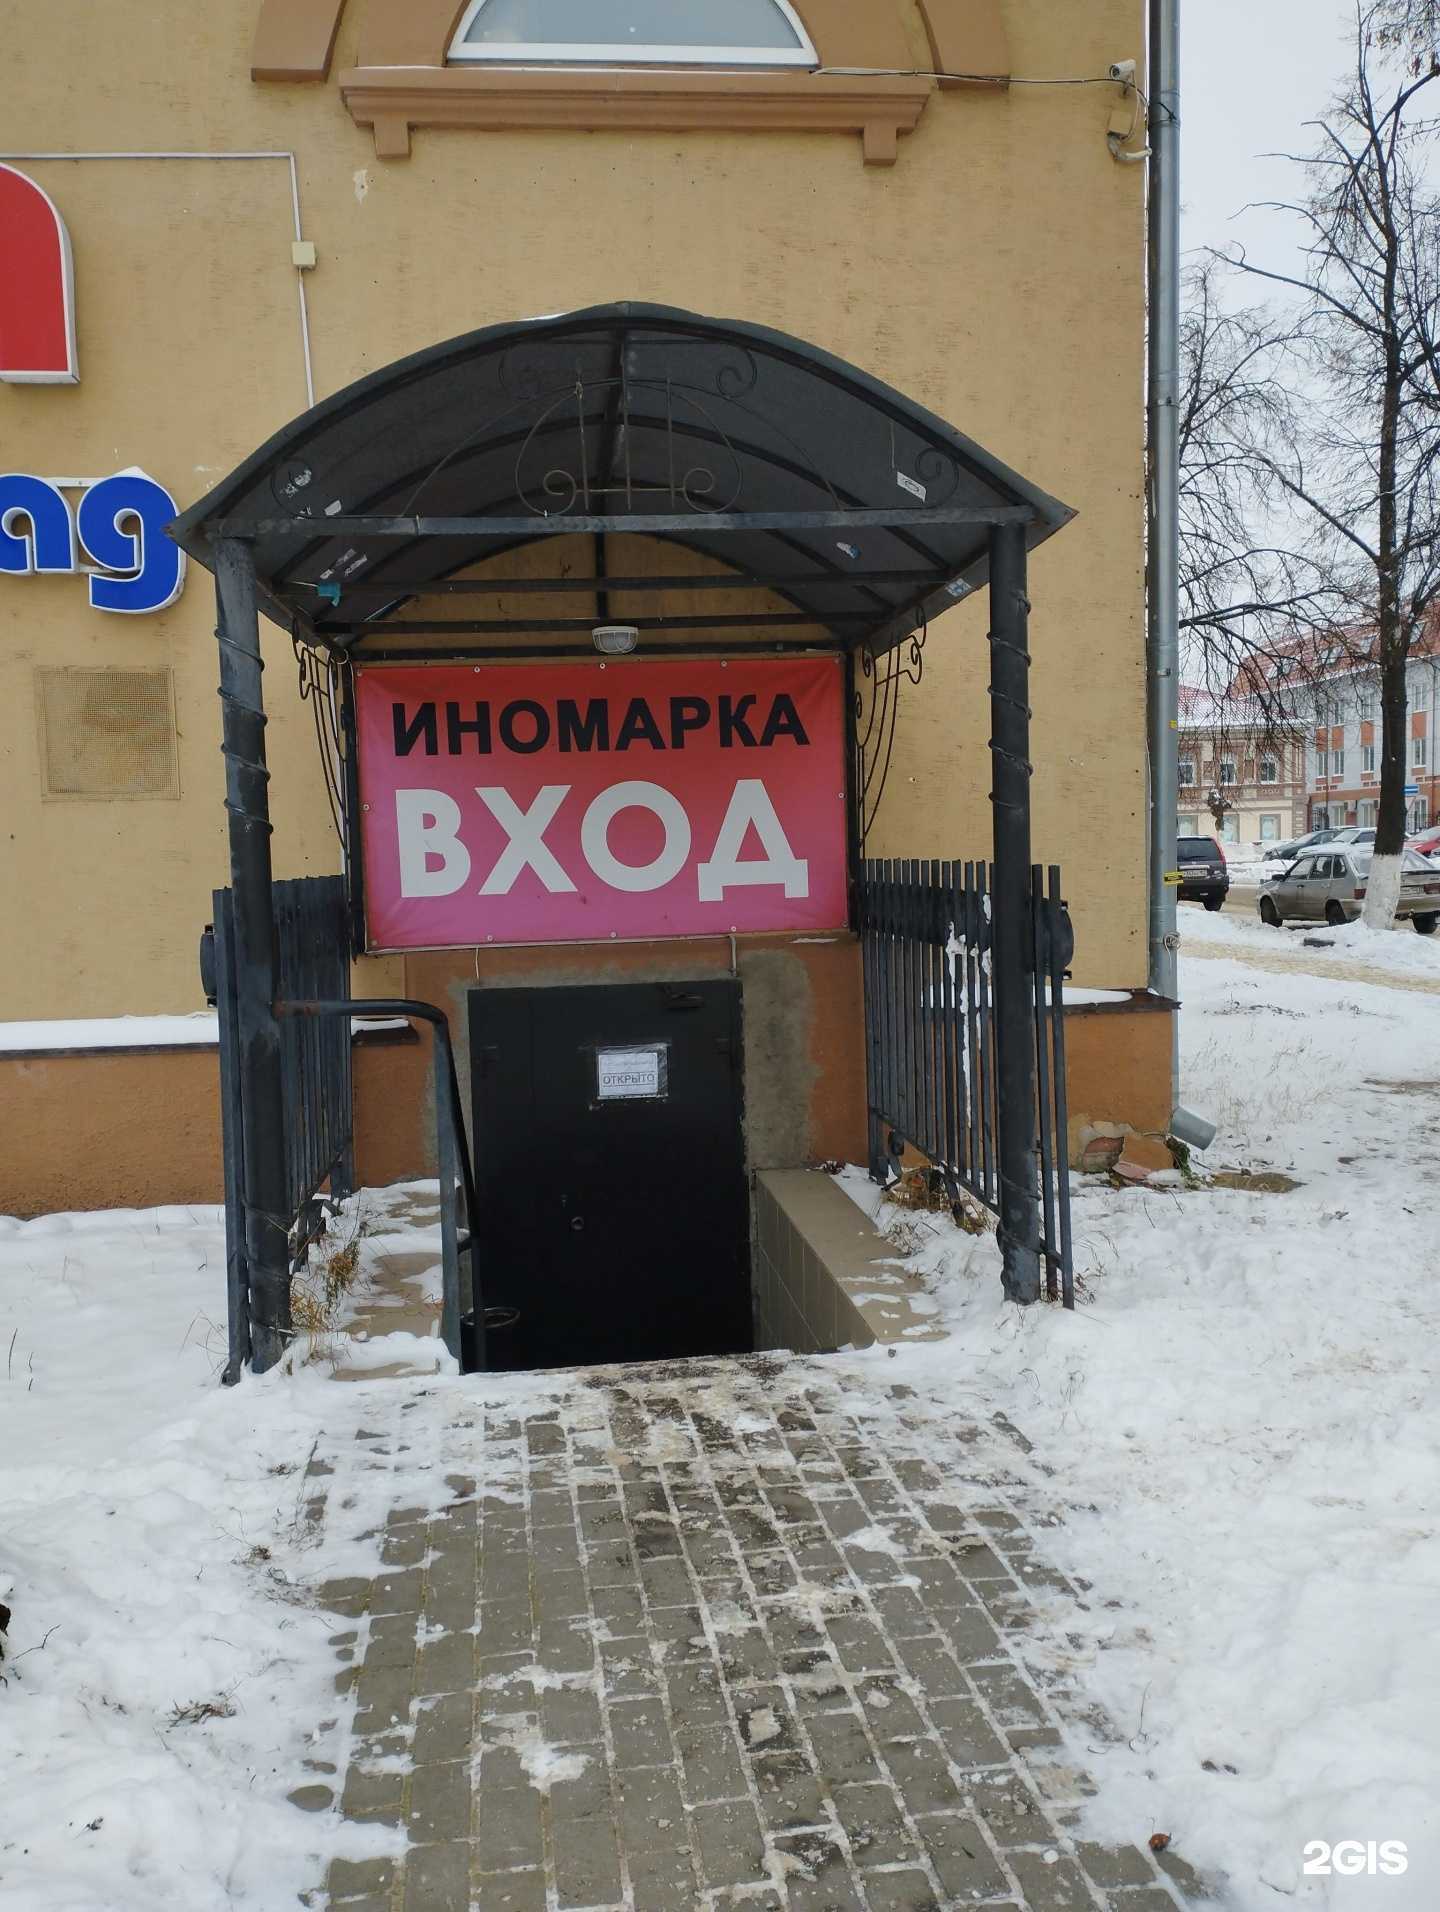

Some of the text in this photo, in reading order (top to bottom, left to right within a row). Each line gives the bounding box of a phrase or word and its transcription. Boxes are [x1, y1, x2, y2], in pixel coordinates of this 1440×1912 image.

[392, 693, 811, 757] ИНОМАРКА
[395, 778, 810, 903] ВХОД
[602, 1073, 655, 1085] ОТКРЫТО
